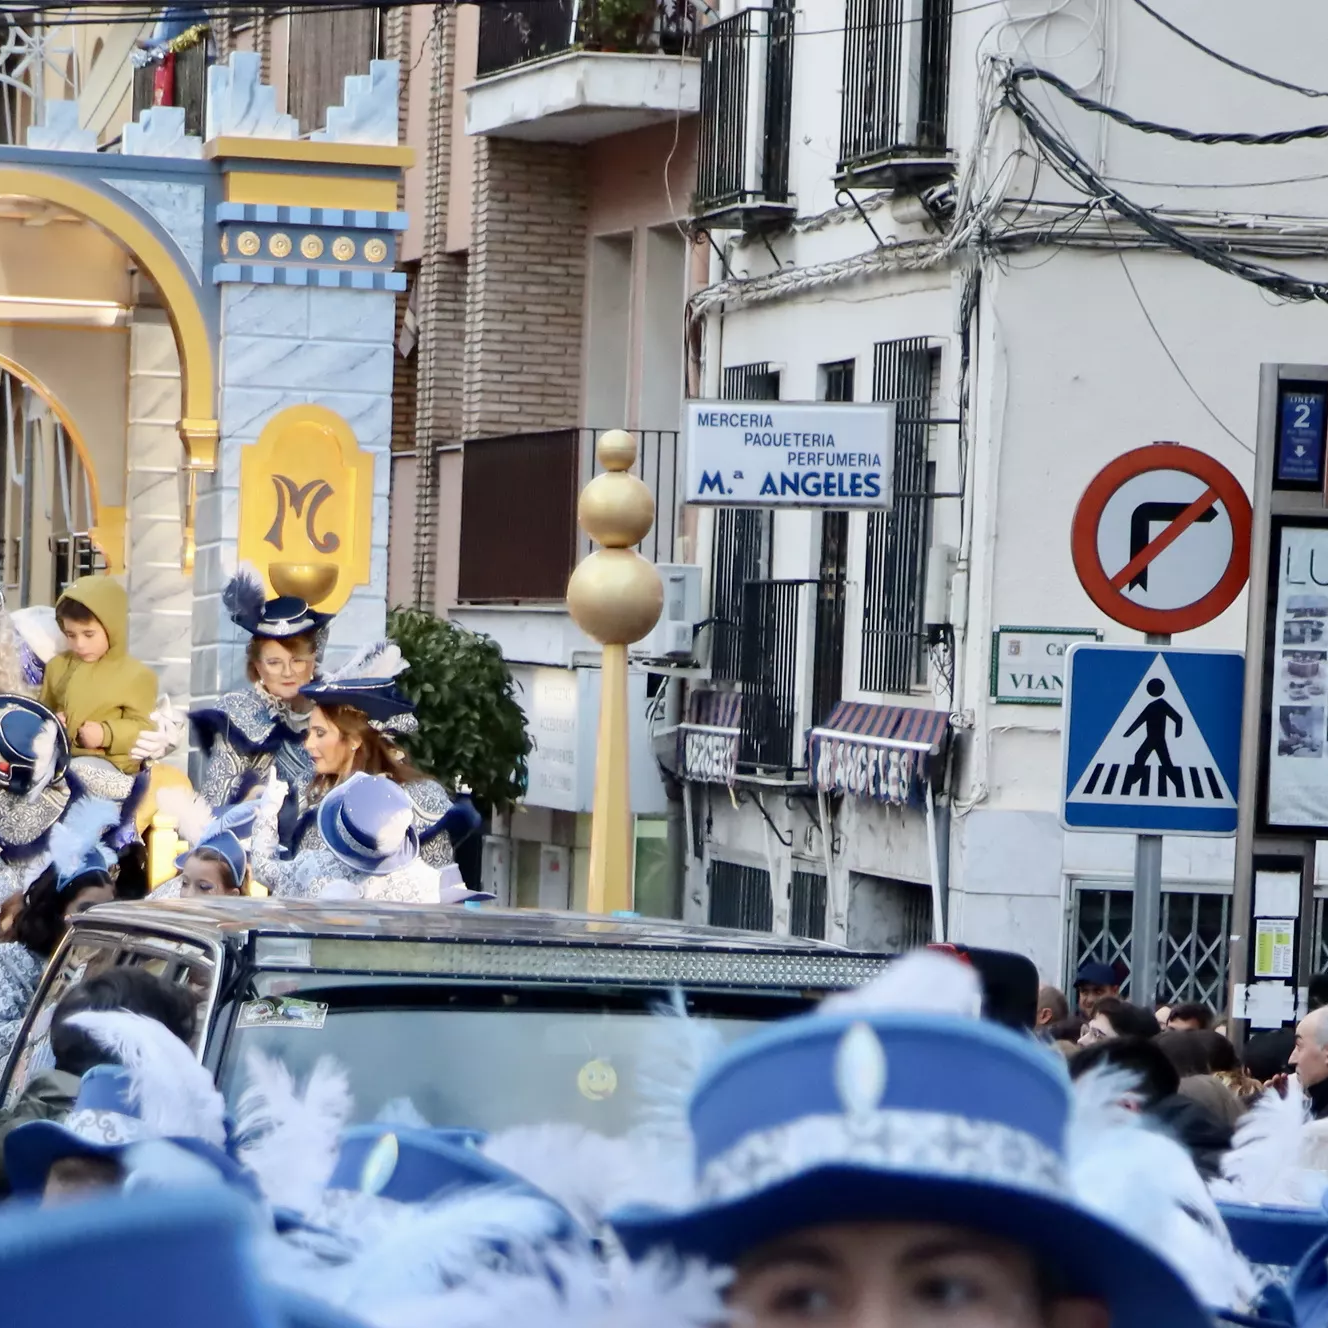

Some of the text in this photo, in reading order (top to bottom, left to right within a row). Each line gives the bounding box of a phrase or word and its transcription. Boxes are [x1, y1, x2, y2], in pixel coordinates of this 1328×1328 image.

[697, 412, 773, 428] MERCERIA
[1293, 404, 1311, 428] 2
[744, 432, 835, 448] PAQUETERIA
[787, 451, 881, 467] PERFUMERIA
[759, 471, 881, 498] ANGELES
[1045, 642, 1070, 656] Cal
